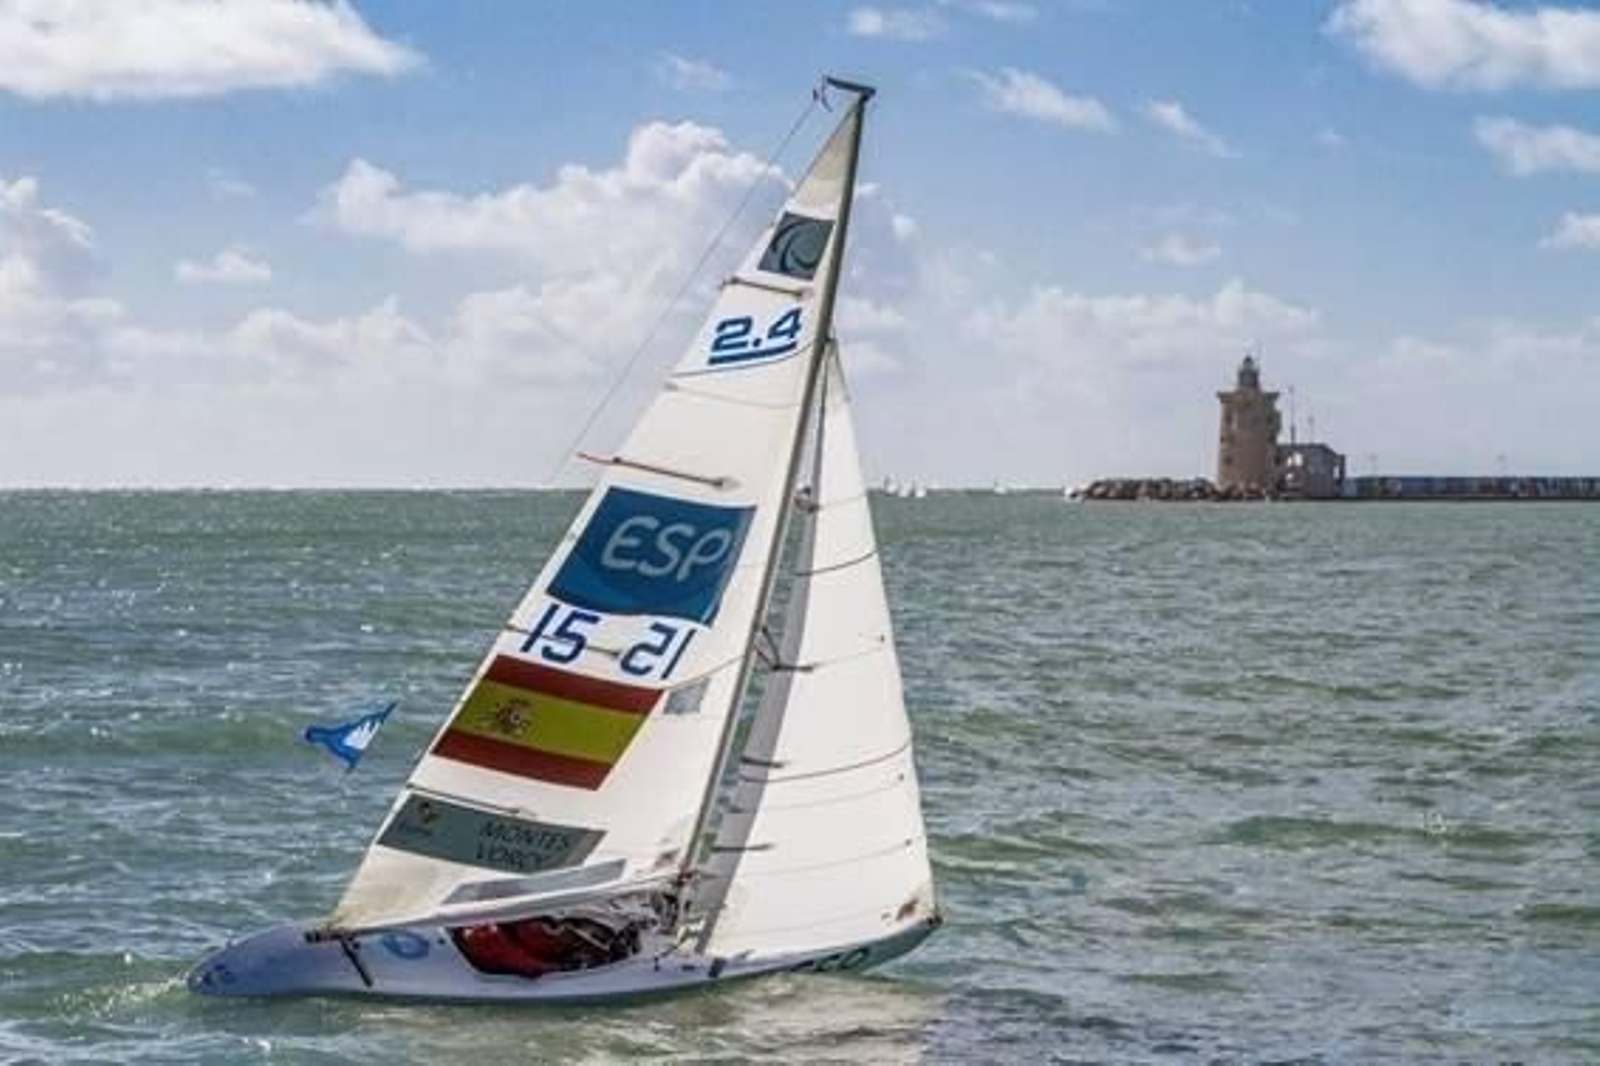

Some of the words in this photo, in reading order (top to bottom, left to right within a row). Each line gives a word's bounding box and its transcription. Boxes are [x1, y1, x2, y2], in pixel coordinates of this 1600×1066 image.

[711, 307, 803, 352] 2.4
[601, 516, 732, 581] ESP
[520, 603, 600, 664] 15
[620, 622, 697, 679] 21
